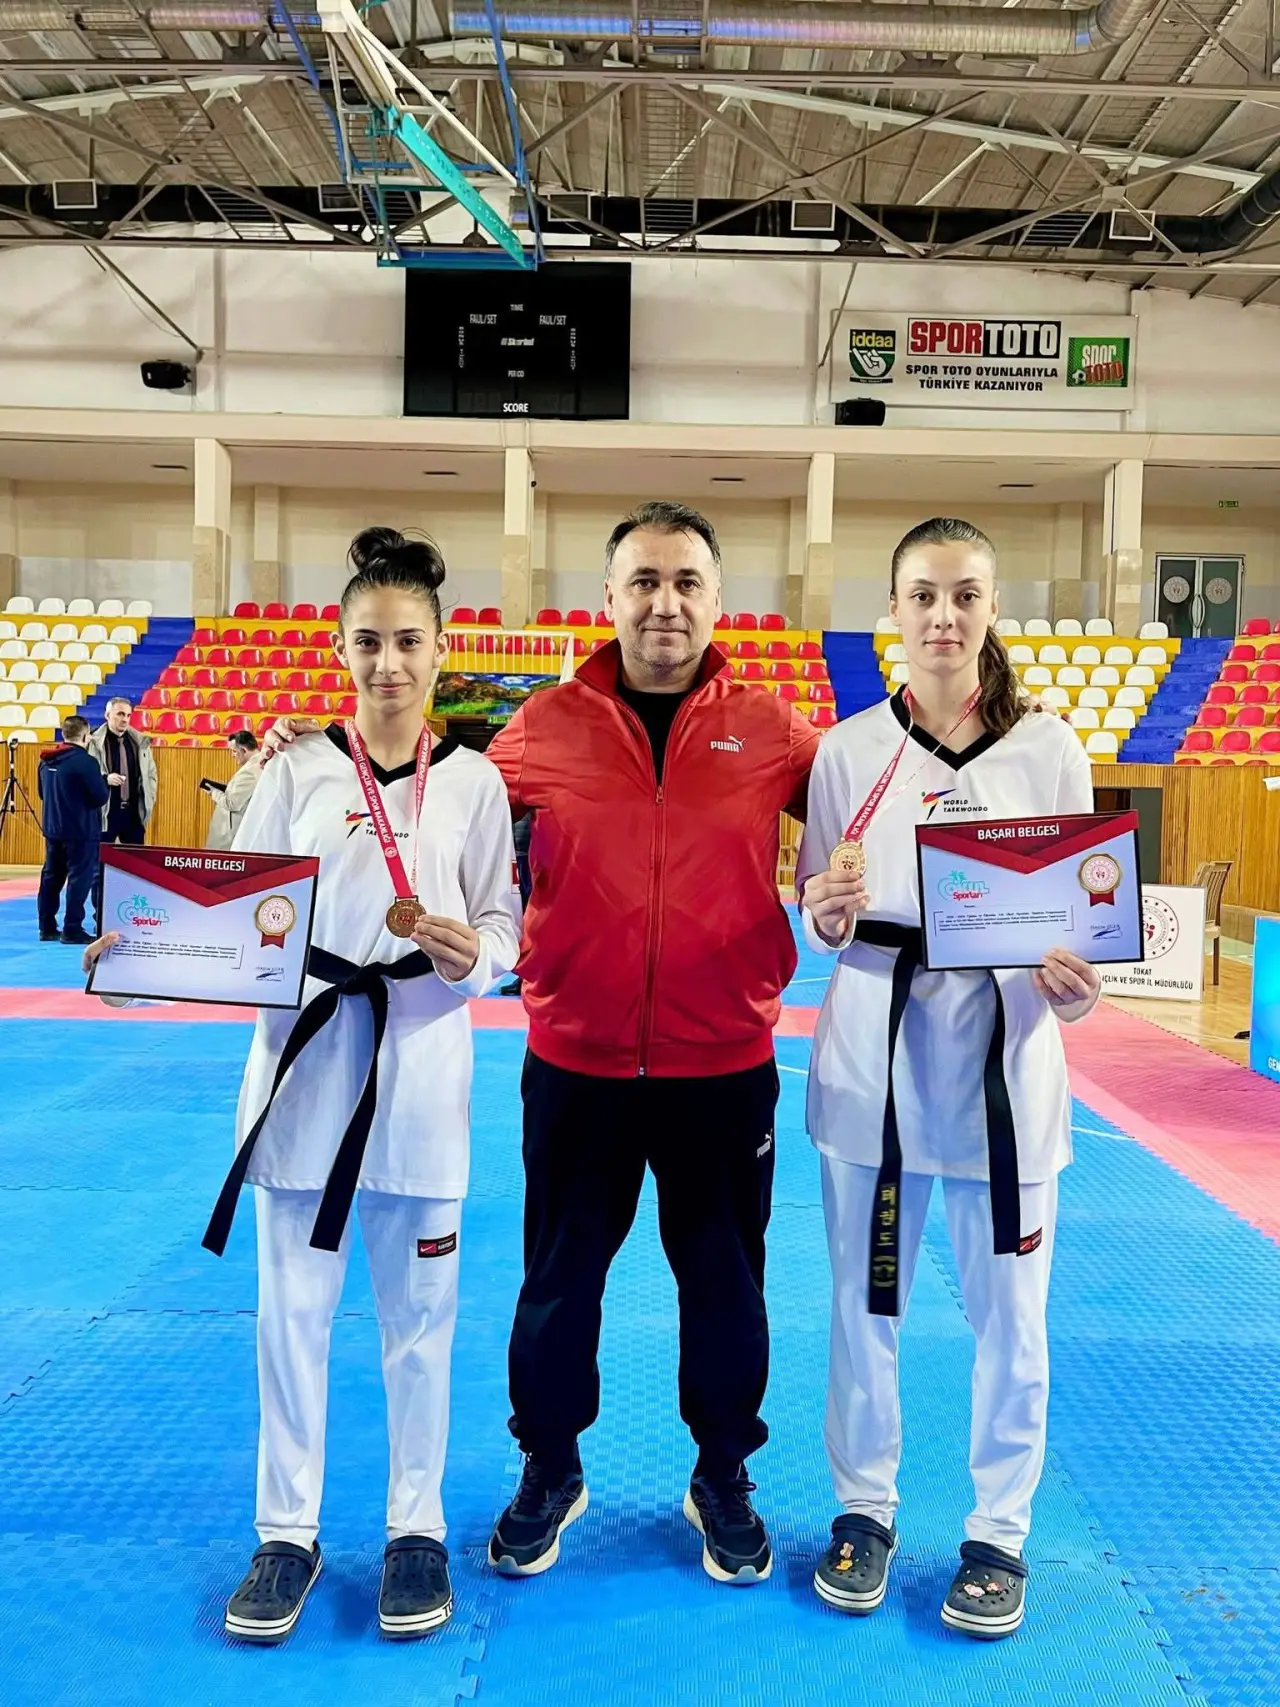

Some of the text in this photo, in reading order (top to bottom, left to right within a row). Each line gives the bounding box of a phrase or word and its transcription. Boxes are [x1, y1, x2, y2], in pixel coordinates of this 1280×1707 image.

[469, 314, 497, 324] FAUL/SET
[539, 315, 567, 325] FAUL/SET
[851, 331, 894, 348] iddaa
[910, 321, 1058, 356] SPOR TOTO
[906, 364, 1058, 377] SPOR TOTO OYUNLARIYLA
[1087, 360, 1124, 384] TOTO
[919, 377, 1043, 391] TÜRKİYE KAZANIYOR
[503, 402, 529, 412] SCORE
[710, 740, 739, 752] PUMA
[977, 823, 1060, 842] BAŞARI BELGESİ
[164, 856, 246, 872] BAŞARI BELGESİ
[1133, 967, 1152, 975] TOKAT
[1119, 976, 1128, 984] VE
[1129, 977, 1146, 986] SPOR
